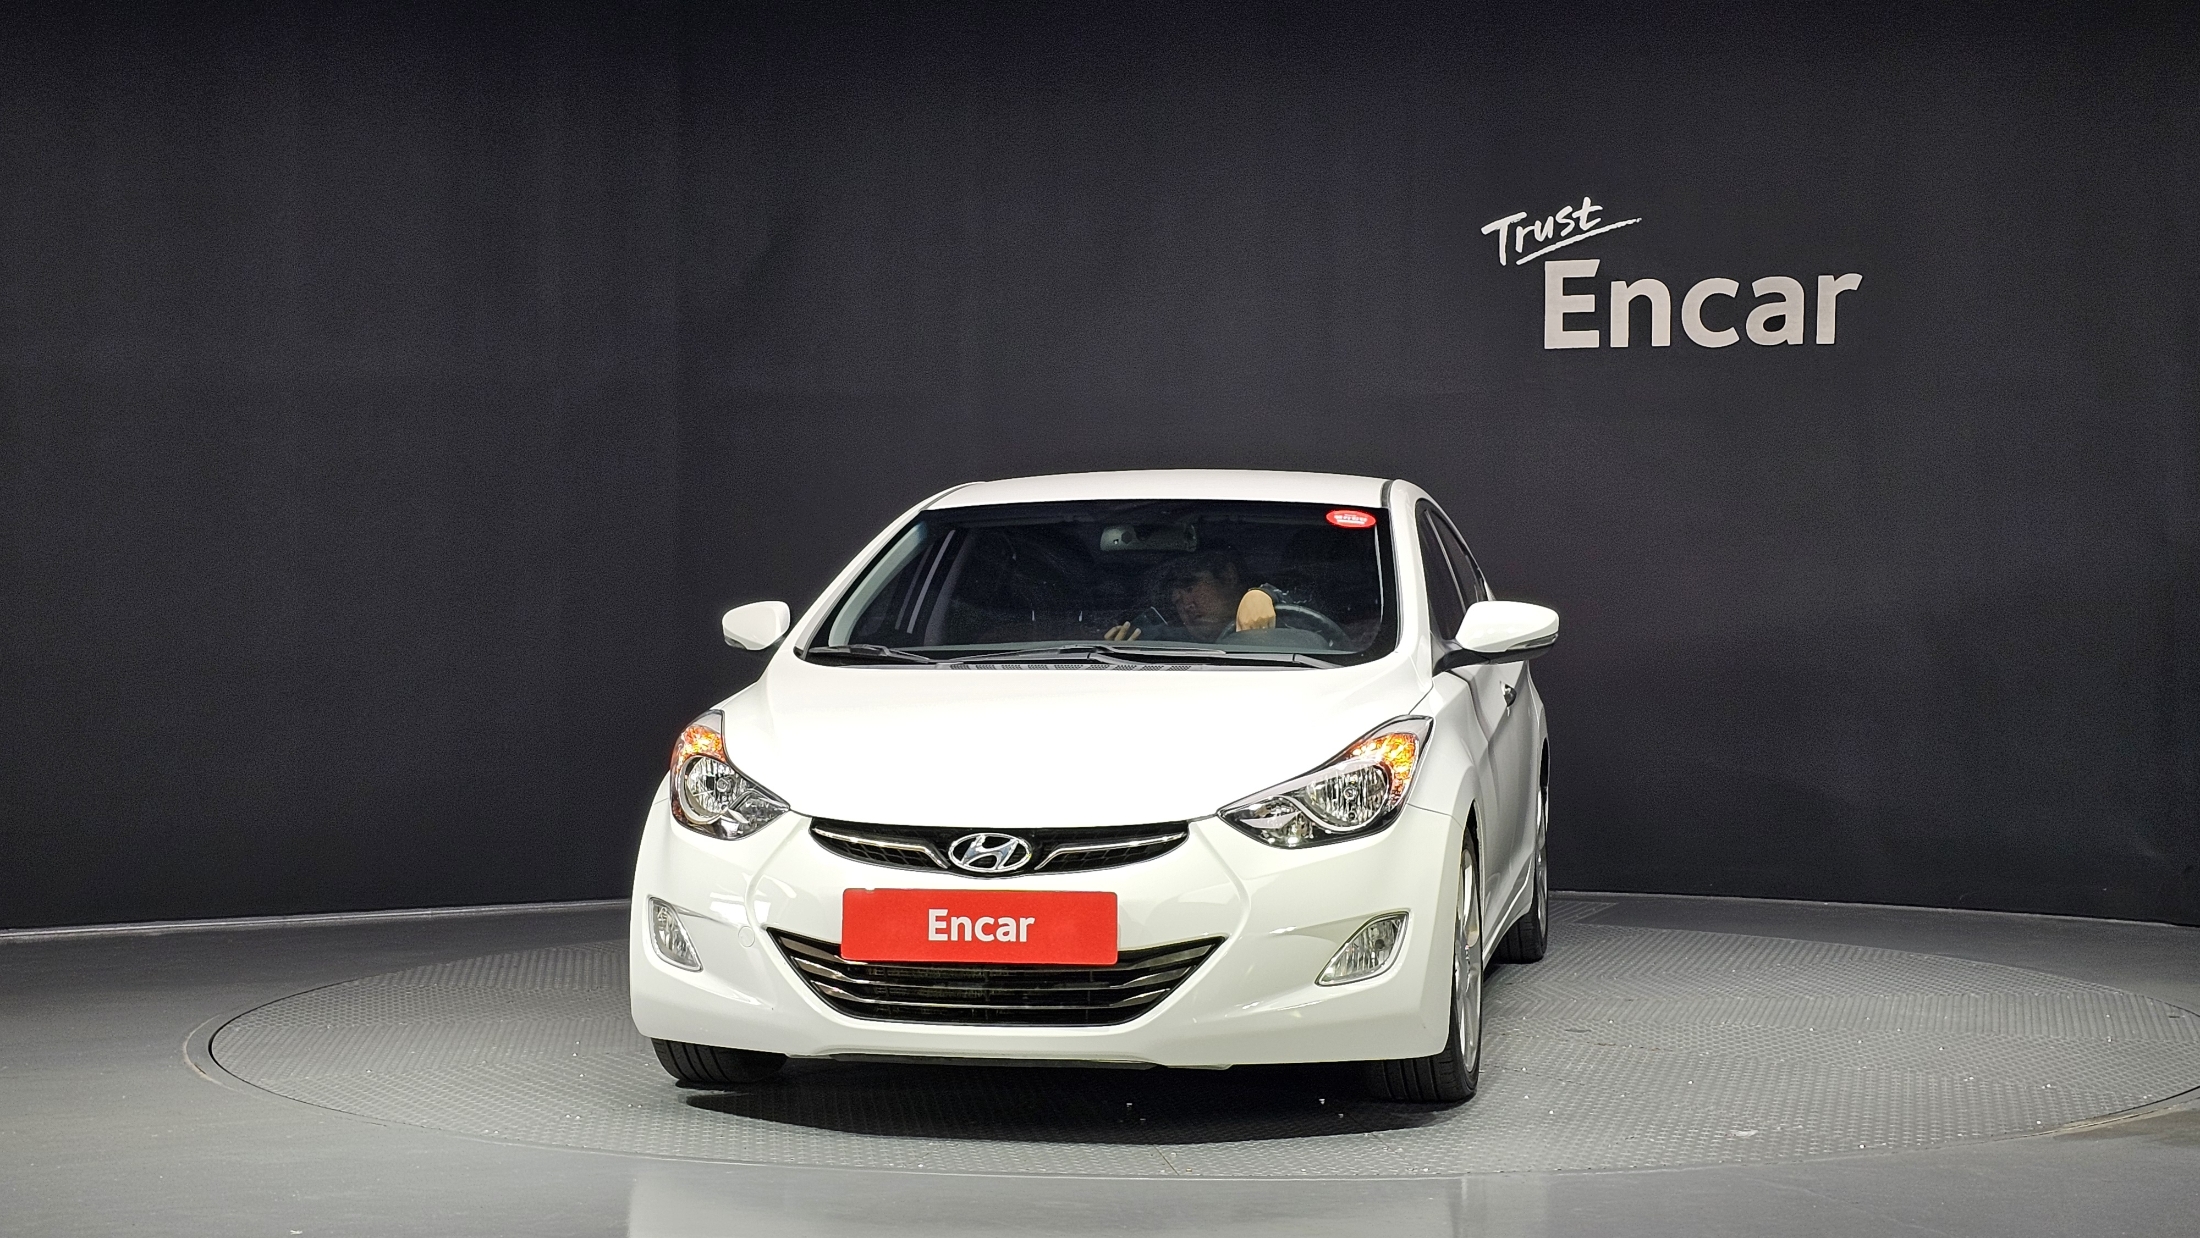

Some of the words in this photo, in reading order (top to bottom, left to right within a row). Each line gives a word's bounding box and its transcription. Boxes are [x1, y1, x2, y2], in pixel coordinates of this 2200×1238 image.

[1481, 196, 1606, 266] Trust
[1543, 258, 1863, 350] Encar
[928, 908, 1036, 943] Encar
